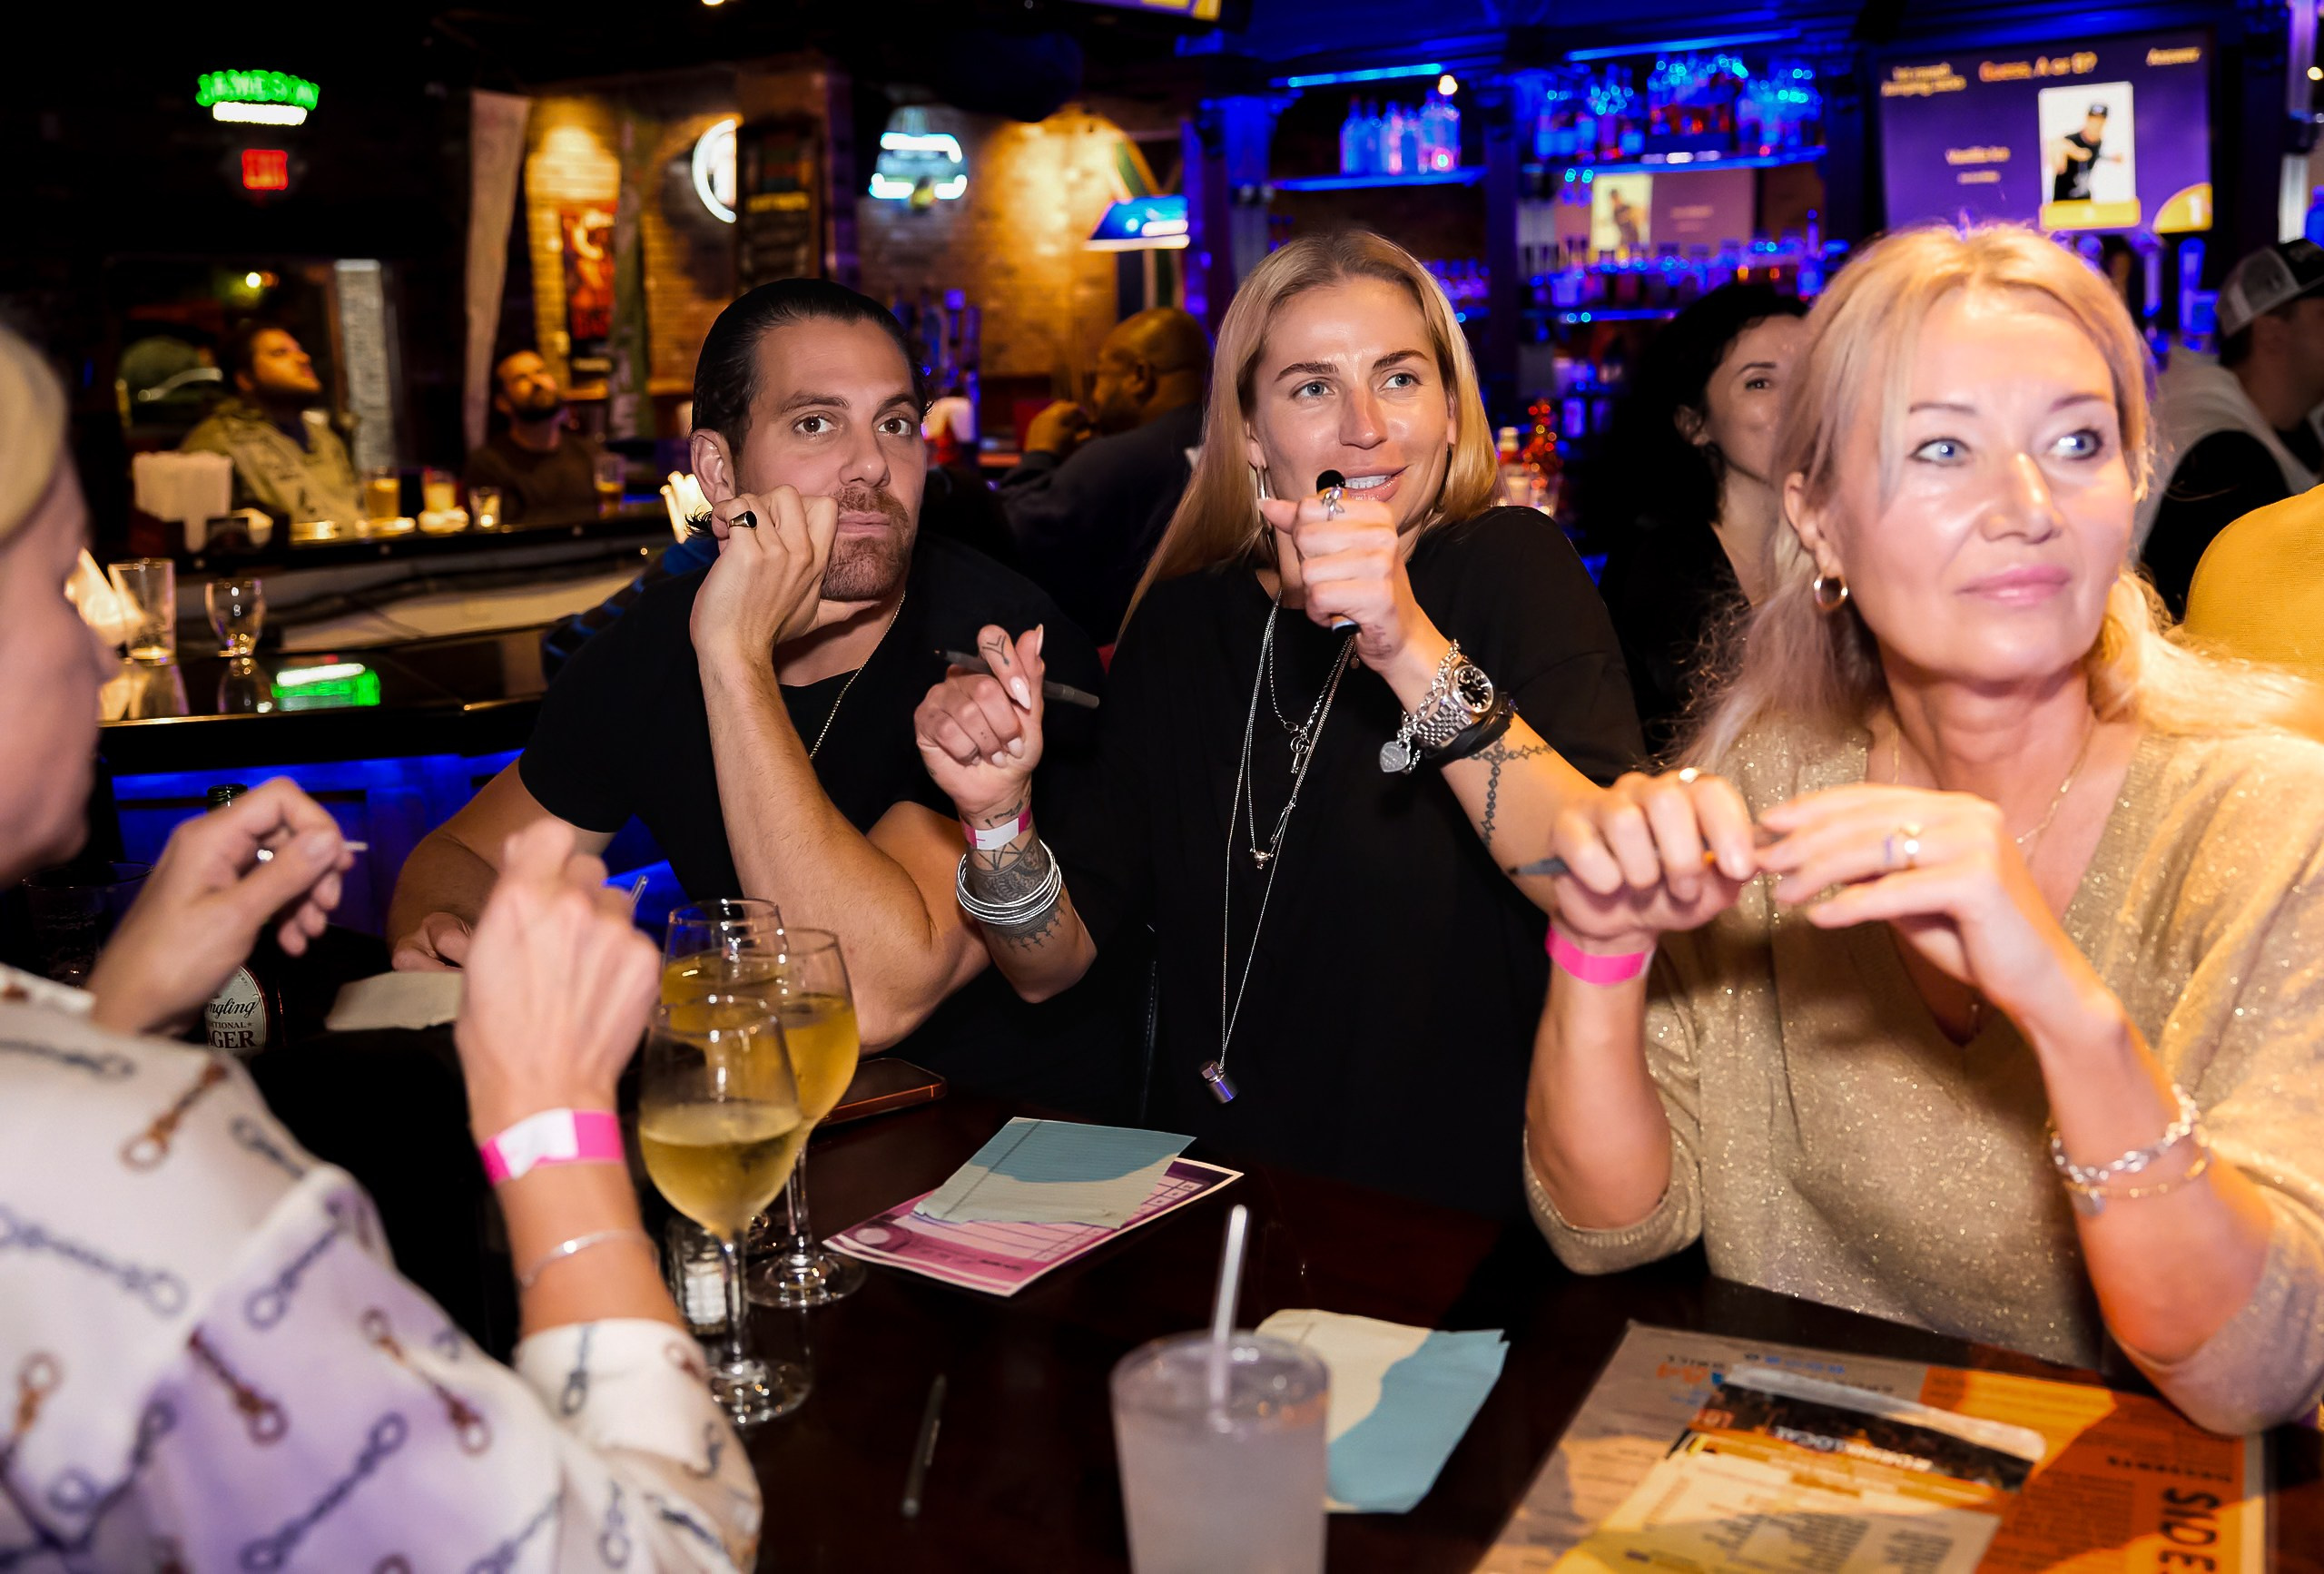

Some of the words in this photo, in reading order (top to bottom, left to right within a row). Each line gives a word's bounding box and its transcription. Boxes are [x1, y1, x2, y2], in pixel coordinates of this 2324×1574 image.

[210, 994, 260, 1018] ngling
[212, 1021, 246, 1029] TIONAL
[210, 1030, 256, 1048] GER
[2159, 1487, 2221, 1574] SIDE
